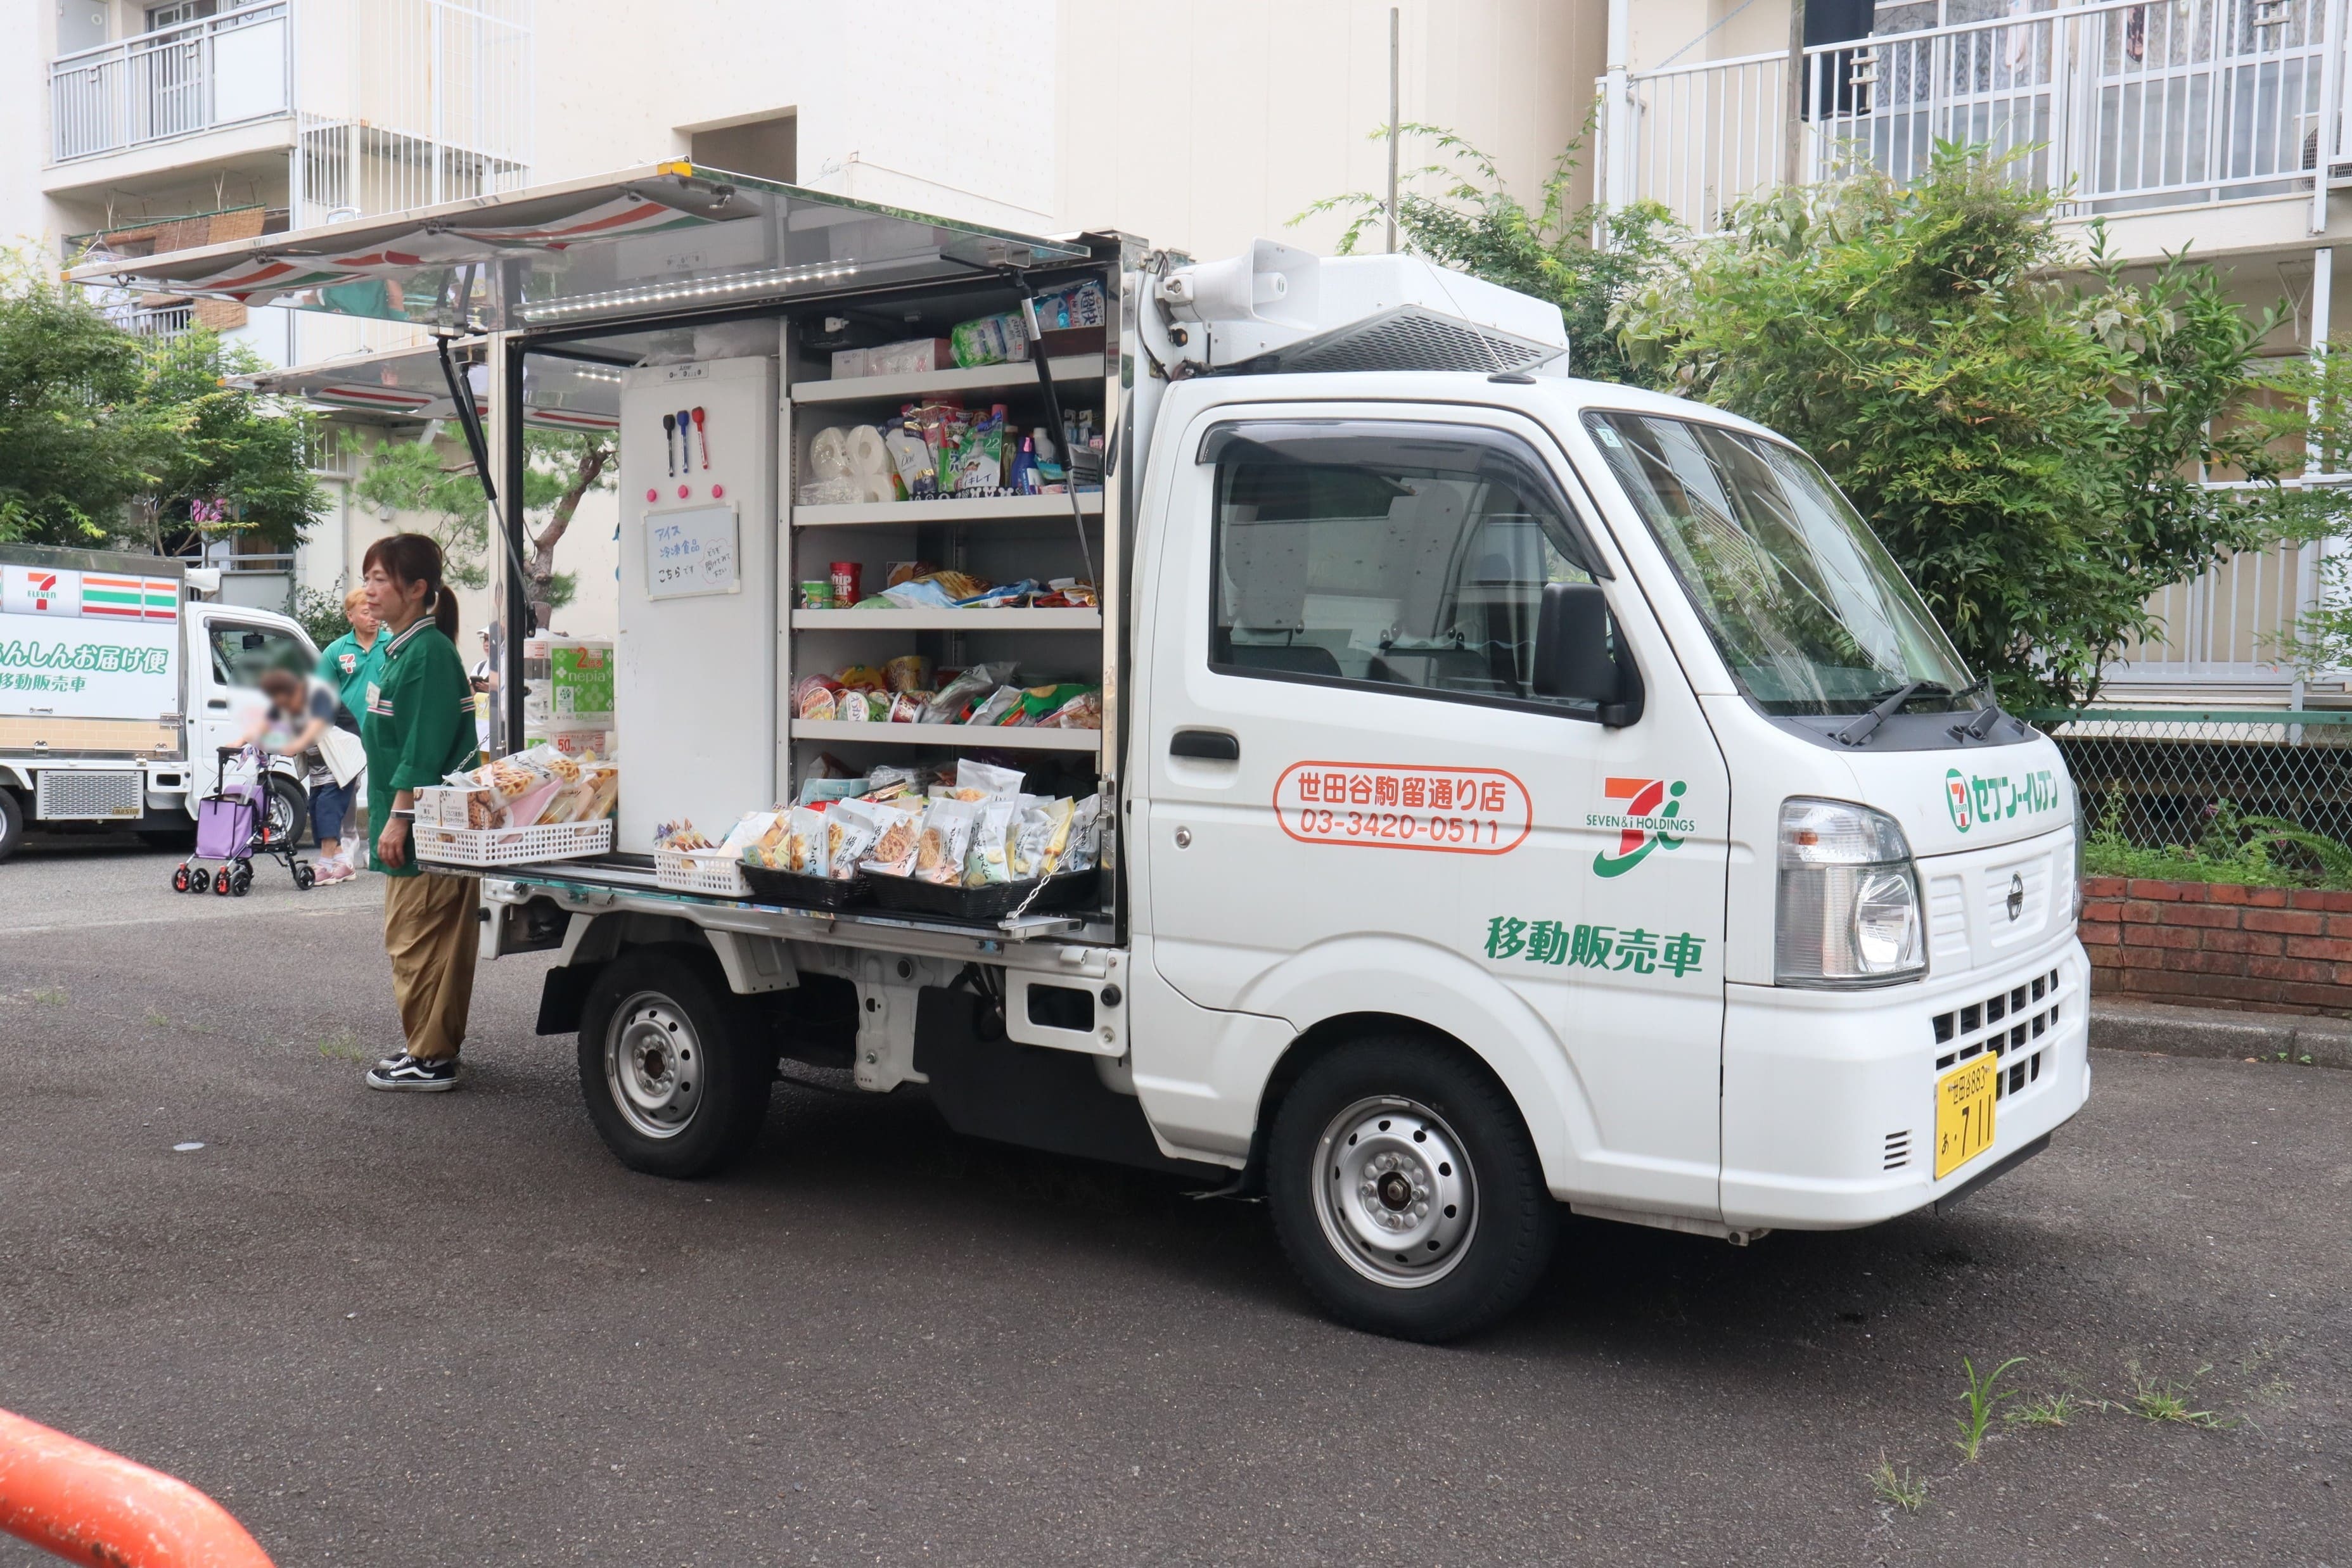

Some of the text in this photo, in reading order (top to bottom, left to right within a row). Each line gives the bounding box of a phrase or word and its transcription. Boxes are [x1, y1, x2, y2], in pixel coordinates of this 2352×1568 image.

[655, 525, 681, 541] アイス
[660, 539, 700, 558] 冷凍食品
[658, 566, 693, 583] こちらです
[0, 672, 87, 692] 移動販売車
[569, 670, 605, 684] nepia
[1299, 772, 1505, 812] 世田谷駒留通り店
[1301, 809, 1498, 844] 03-3420-0511
[1637, 817, 1695, 832] HOLDINGS
[1485, 916, 1706, 978] 移動販売車
[1941, 1131, 1950, 1155] あ
